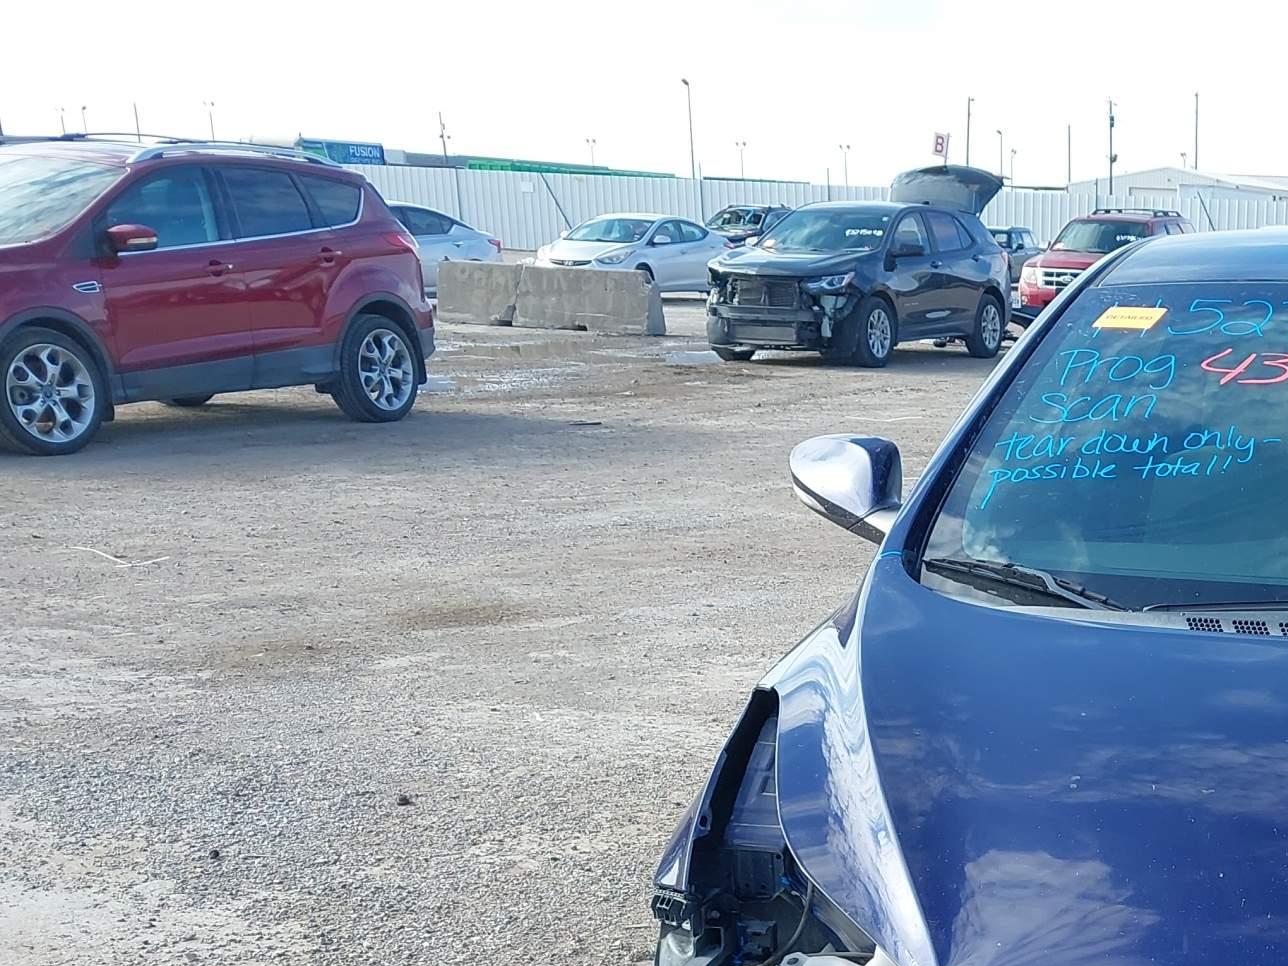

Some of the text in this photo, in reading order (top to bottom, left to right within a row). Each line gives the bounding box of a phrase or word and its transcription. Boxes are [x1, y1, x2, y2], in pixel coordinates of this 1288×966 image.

[349, 145, 380, 158] FUSION
[934, 135, 945, 154] B
[1059, 349, 1176, 389] Prog
[994, 431, 1077, 462] tear
[1081, 428, 1169, 455] down
[981, 456, 1117, 510] possible
